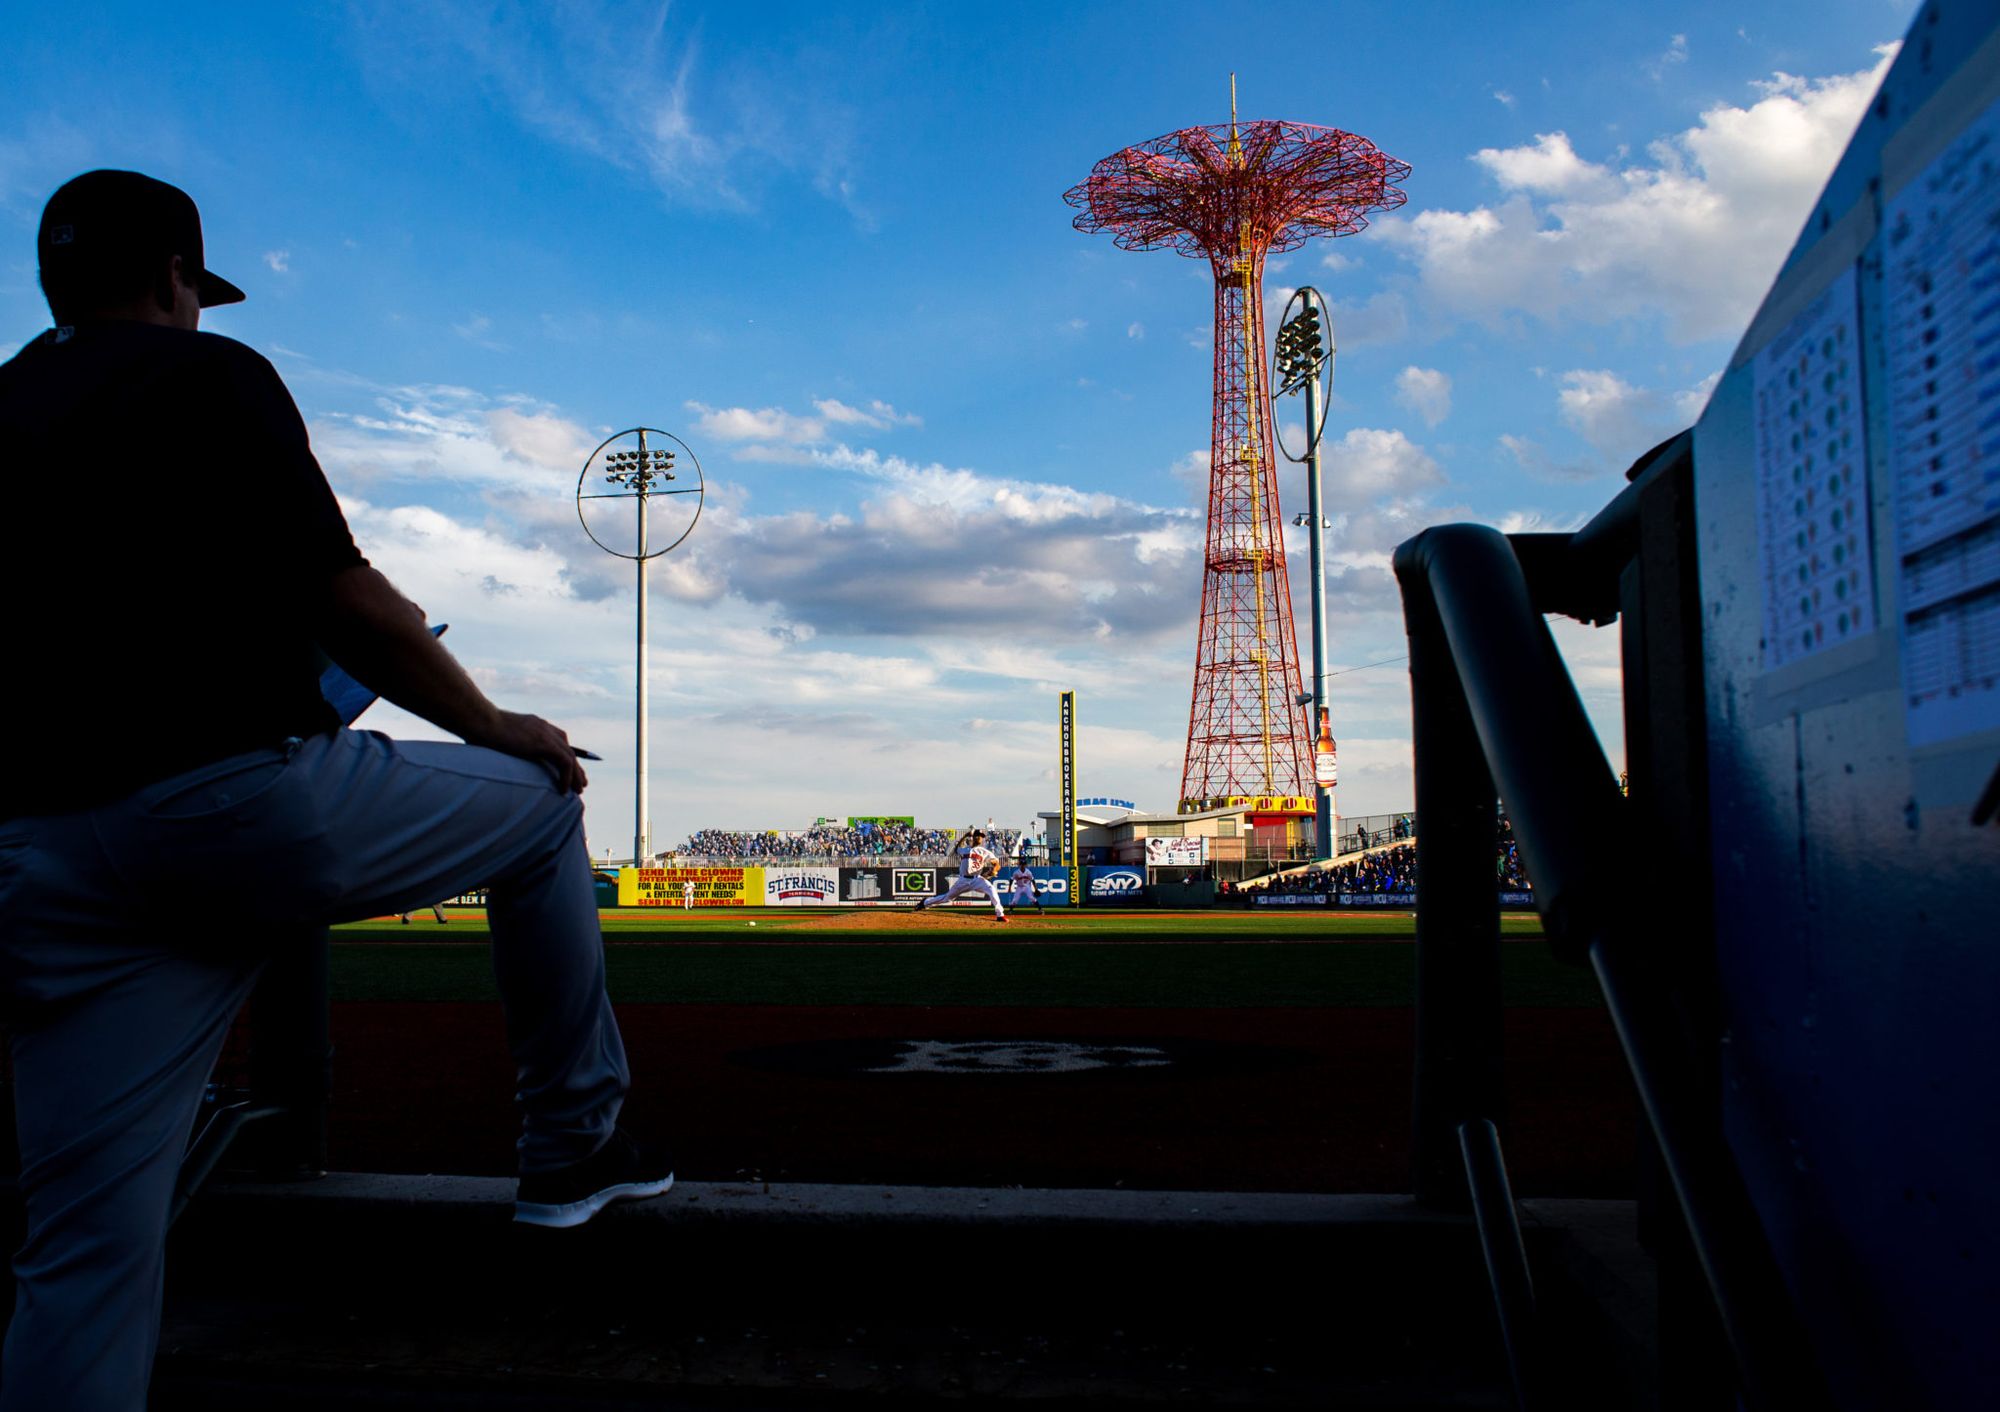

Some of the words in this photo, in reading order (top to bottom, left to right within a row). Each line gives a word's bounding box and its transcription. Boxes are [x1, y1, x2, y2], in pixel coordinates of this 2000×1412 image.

[638, 882, 651, 890] FOR
[654, 882, 665, 890] ALL
[694, 882, 711, 890] ARTY
[714, 882, 744, 890] RENTALS
[784, 877, 835, 894] FRANCIS
[897, 873, 931, 891] TGI
[1070, 869, 1078, 904] 325
[1091, 878, 1134, 891] SNY
